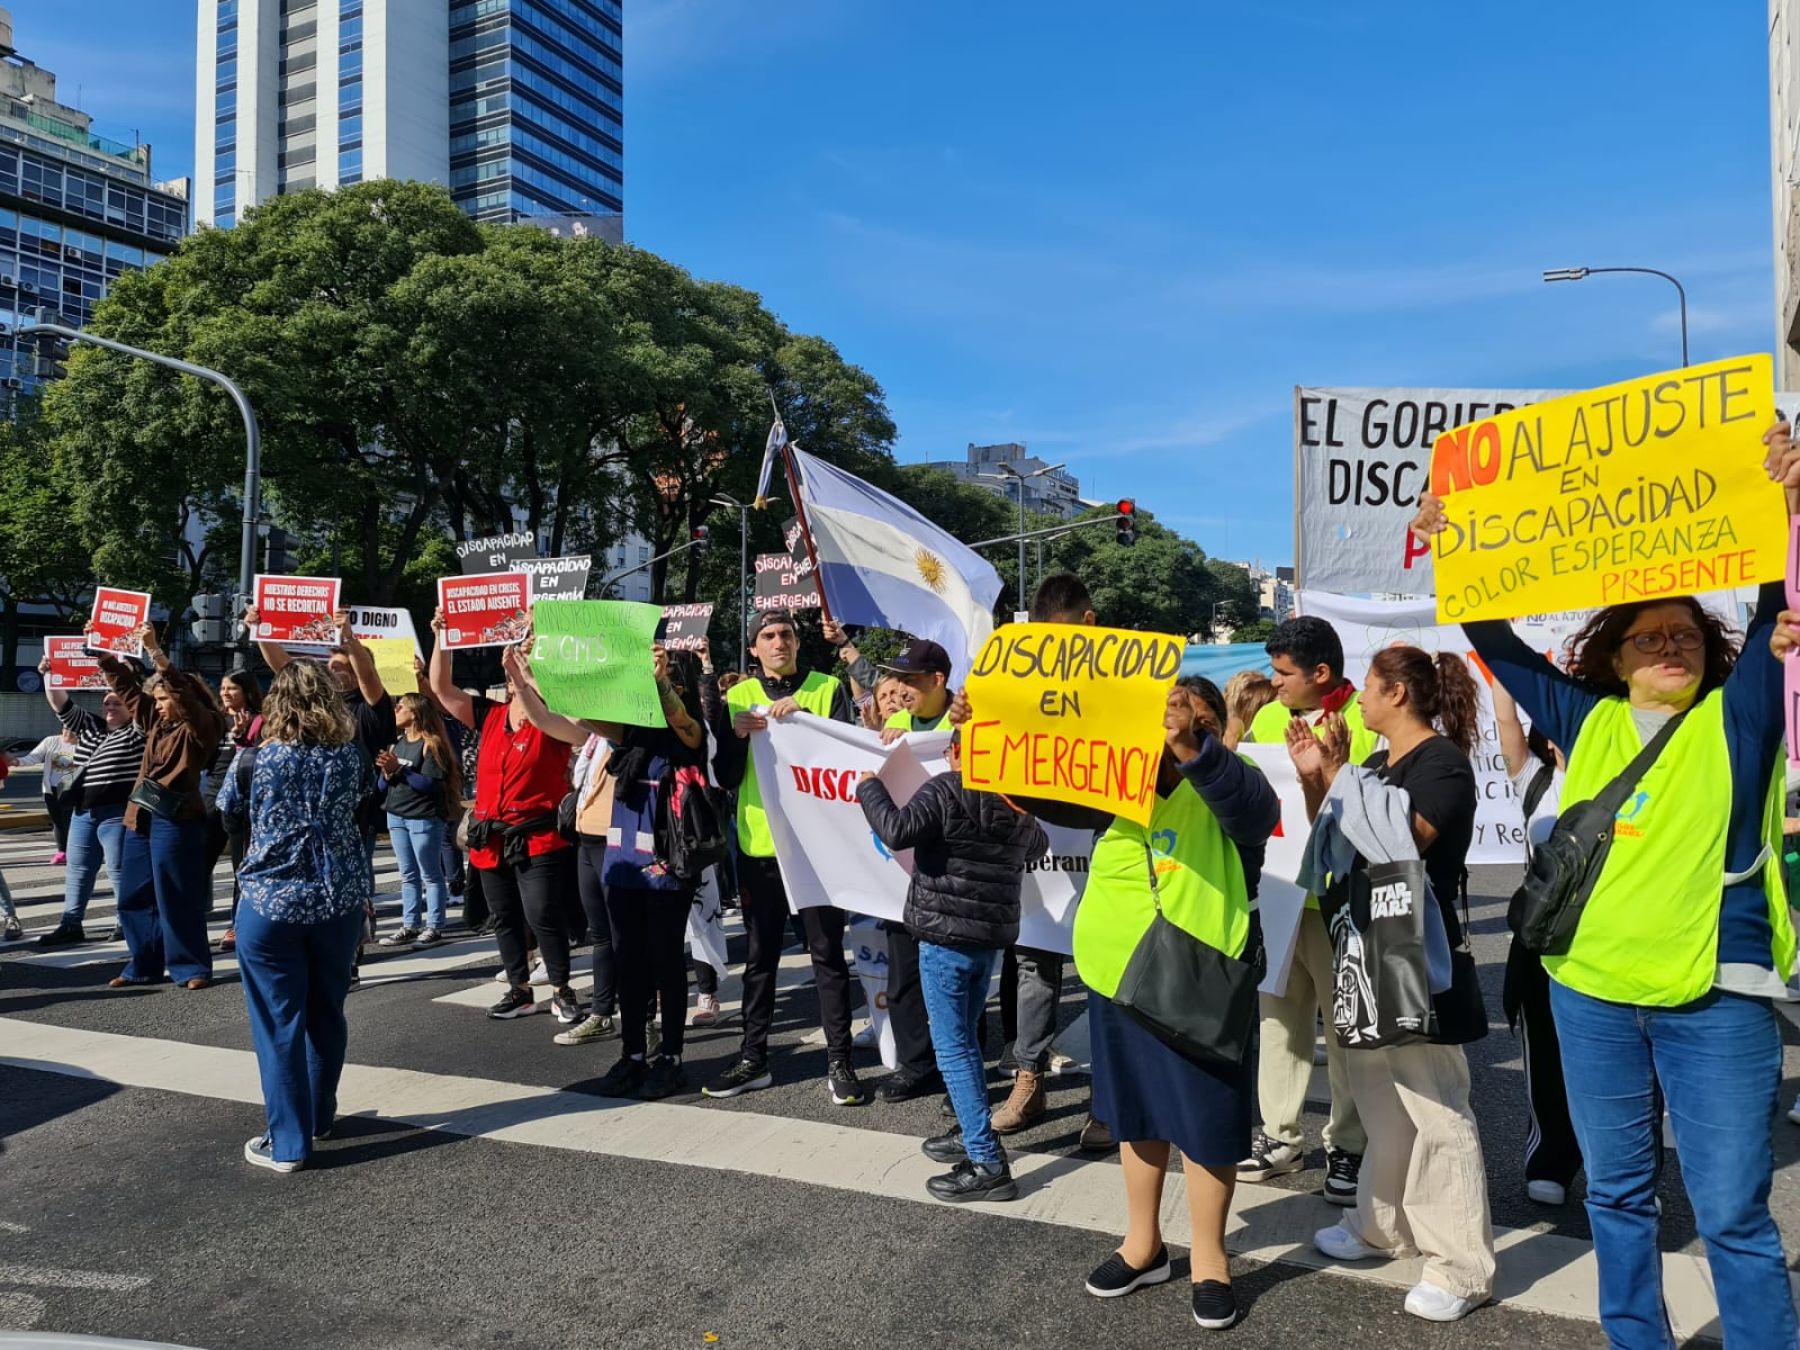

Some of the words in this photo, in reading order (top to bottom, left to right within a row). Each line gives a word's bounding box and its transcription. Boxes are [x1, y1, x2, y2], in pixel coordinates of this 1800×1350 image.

[1300, 397, 1343, 447] EL
[1432, 422, 1501, 496] NO
[1506, 417, 1561, 481] AL
[1565, 365, 1756, 466] AJUSTE
[1559, 466, 1600, 494] EN
[489, 553, 506, 567] EN
[1444, 557, 1539, 618] COLOR
[1550, 515, 1738, 577] ESPERANZA
[540, 576, 559, 588] EN
[781, 573, 797, 585] EN
[1602, 549, 1757, 603] PRESENTE
[297, 585, 329, 597] DERECHOS
[446, 586, 489, 599] DISCAPACIDAD
[489, 585, 498, 594] EN
[756, 592, 821, 609] EMERGENCI
[263, 597, 275, 610] NO
[277, 598, 287, 611] SE
[288, 599, 327, 613] RECORTAN
[448, 601, 458, 614] EL
[458, 599, 486, 612] ESTADO
[487, 596, 521, 610] AUSENTE
[661, 605, 713, 618] CAPACIDAD
[362, 611, 398, 628] DIGNO
[666, 621, 682, 633] EN
[973, 634, 1182, 682] DISCAPACIDAD
[1040, 690, 1081, 718] EN
[970, 720, 1160, 808] EMERGENCIA
[790, 765, 861, 803] DISC
[1496, 824, 1525, 846] Re
[1020, 853, 1088, 874] peran
